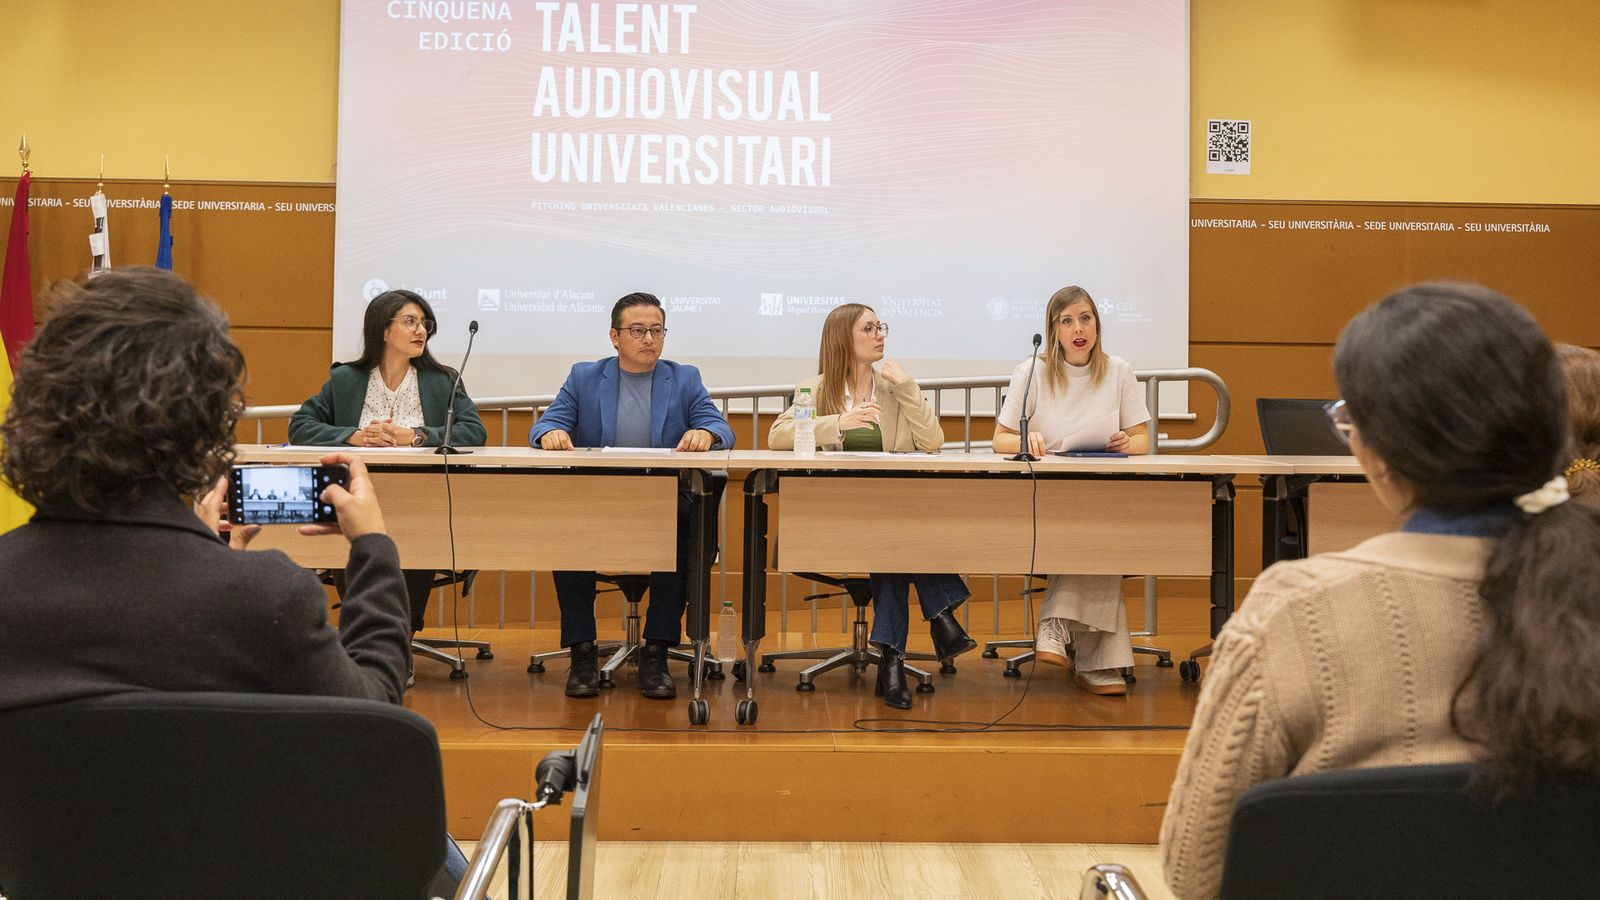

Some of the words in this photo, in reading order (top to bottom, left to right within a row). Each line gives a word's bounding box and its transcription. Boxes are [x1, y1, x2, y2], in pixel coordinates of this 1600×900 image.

[387, 1, 512, 23] CINQUENA
[535, 2, 698, 54] TALENT
[418, 28, 512, 51] EDICIÓ
[533, 66, 832, 121] AUDIOVISUAL
[531, 132, 832, 187] UNIVERSITARI
[73, 198, 91, 208] SEU
[107, 197, 161, 210] IVERSITÀRIA
[172, 200, 195, 210] SEDE
[197, 201, 266, 211] UNIVERSITARIA
[275, 202, 292, 212] SEU
[1191, 218, 1257, 229] UNIVERSITARIA
[1268, 220, 1286, 230] SEU
[1288, 218, 1354, 231] UNIVERSITÀRIA
[1364, 221, 1387, 231] SEDE
[1389, 222, 1455, 232] UNIVERSITARIA
[1465, 222, 1482, 232] SEU
[1484, 221, 1551, 233] UNIVERSITÀRIA
[670, 295, 721, 304] UNIVERSITAT
[786, 295, 846, 305] UNIVERSITAS
